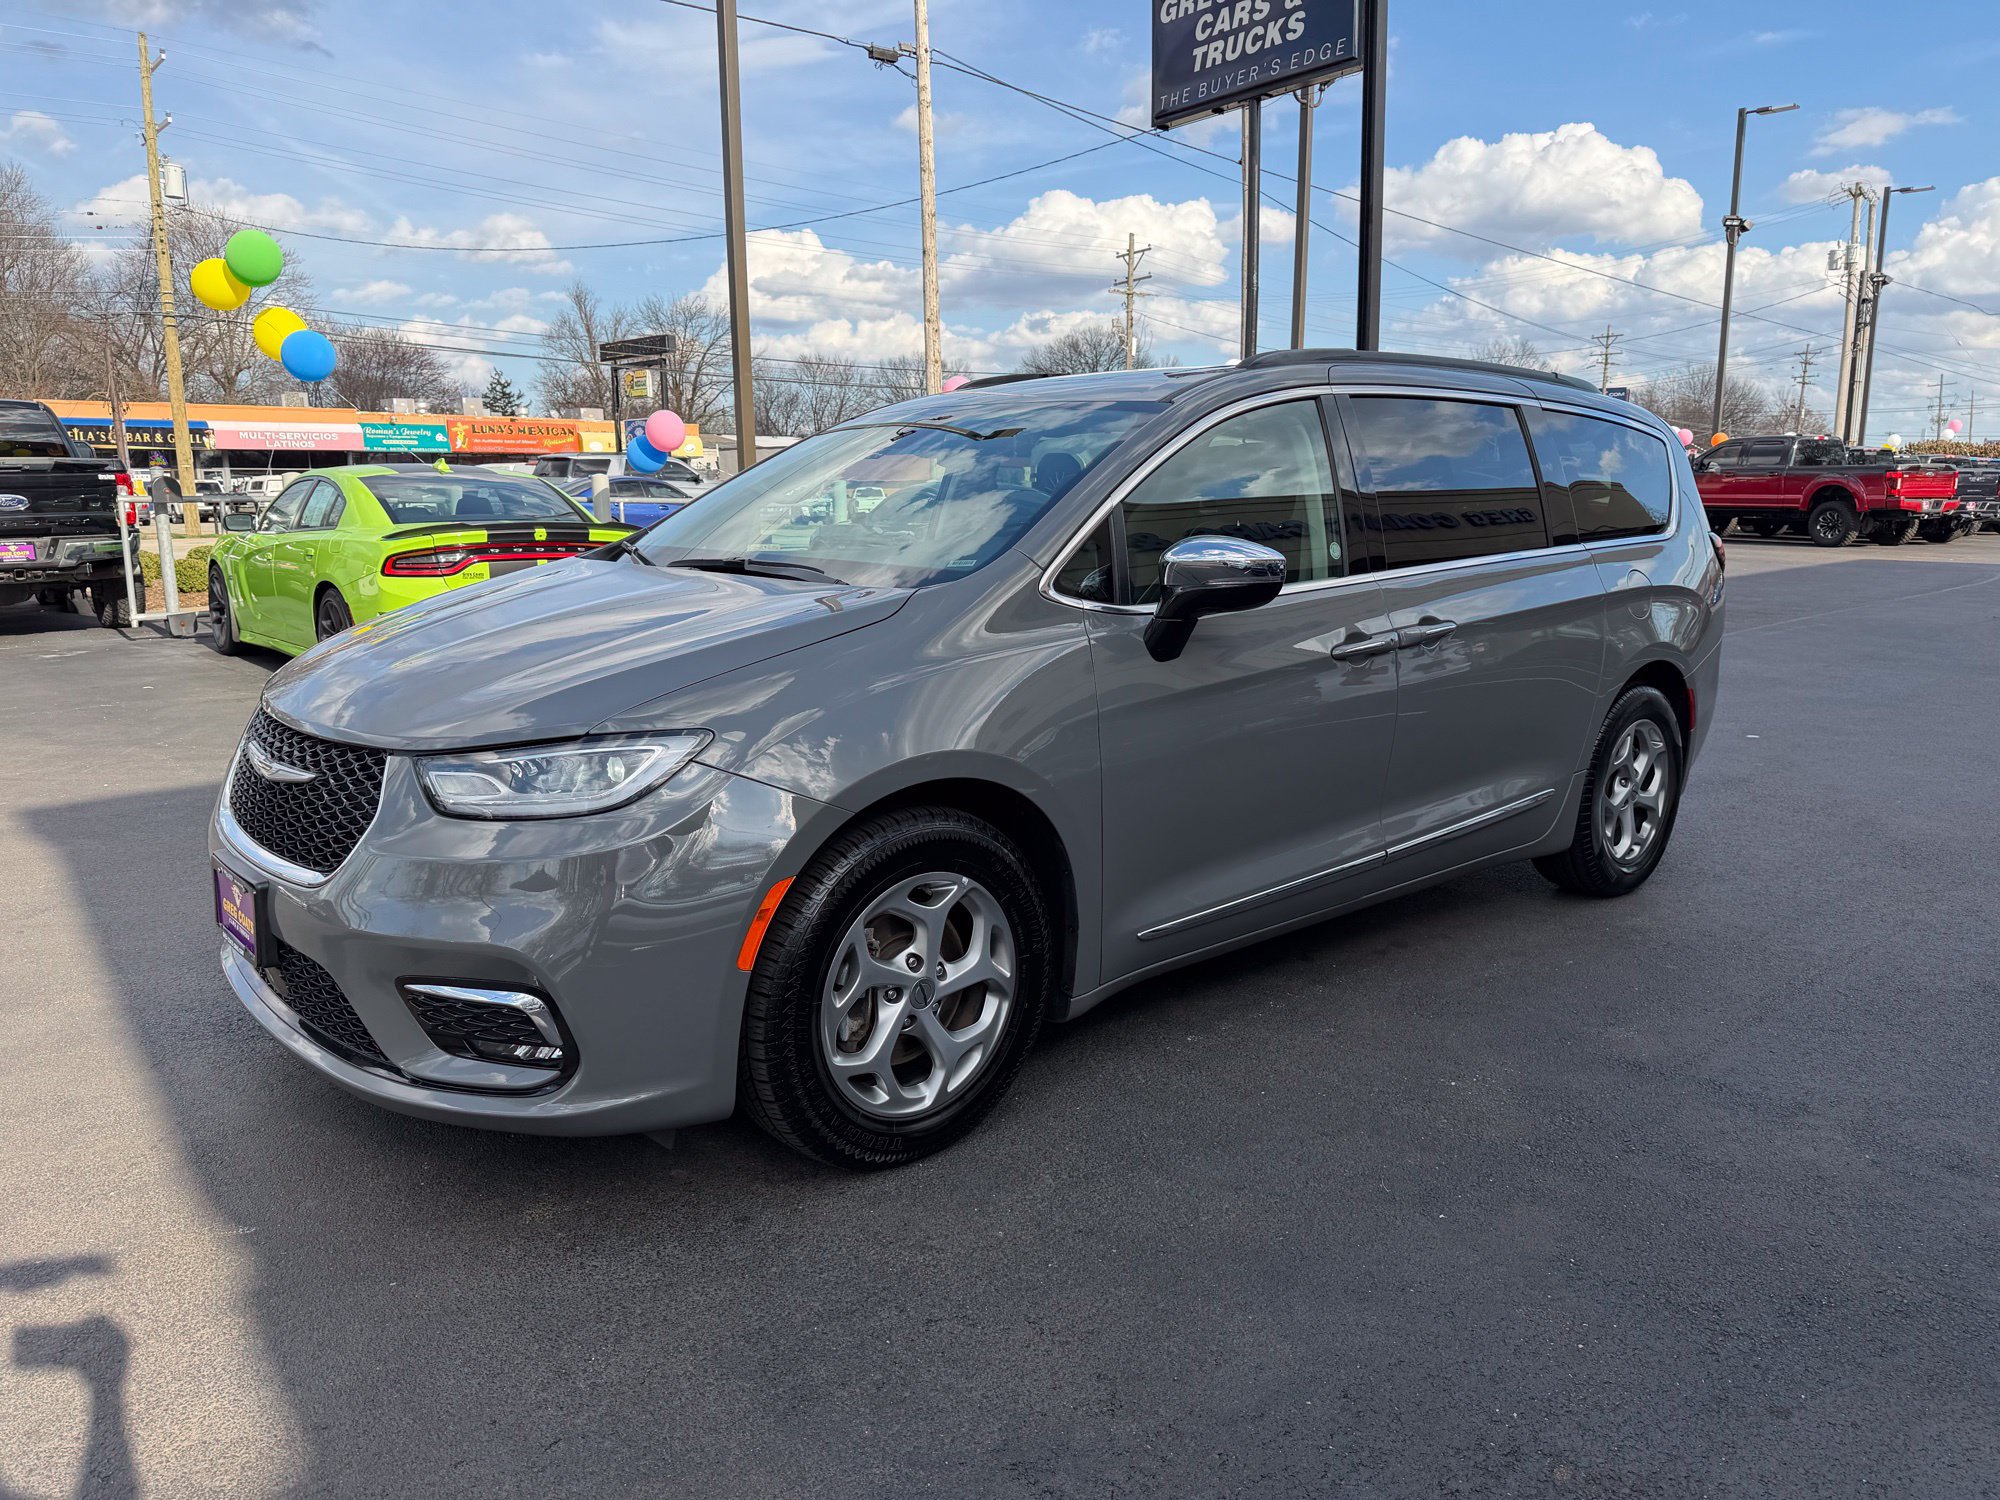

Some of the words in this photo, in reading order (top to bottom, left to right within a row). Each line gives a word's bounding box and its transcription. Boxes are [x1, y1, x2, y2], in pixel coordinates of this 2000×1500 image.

[1160, 0, 1225, 23] GR
[1195, 0, 1270, 41] CARS
[1192, 11, 1306, 72] TRUCKS
[1160, 87, 1191, 110] THE
[1198, 58, 1281, 98] BUYER'S
[1289, 38, 1347, 70] EDGE
[66, 428, 107, 442] EILA'S
[126, 432, 151, 443] BAR
[154, 432, 164, 443] &
[167, 433, 202, 444] GLL
[239, 431, 338, 440] MULTI-SERVICIOS
[400, 427, 431, 437] Jewelry
[471, 424, 514, 435] LUNA'S
[517, 425, 575, 437] MEXICAN
[265, 440, 315, 448] LATINOS
[223, 897, 238, 919] GREG
[238, 909, 254, 935] COATS
